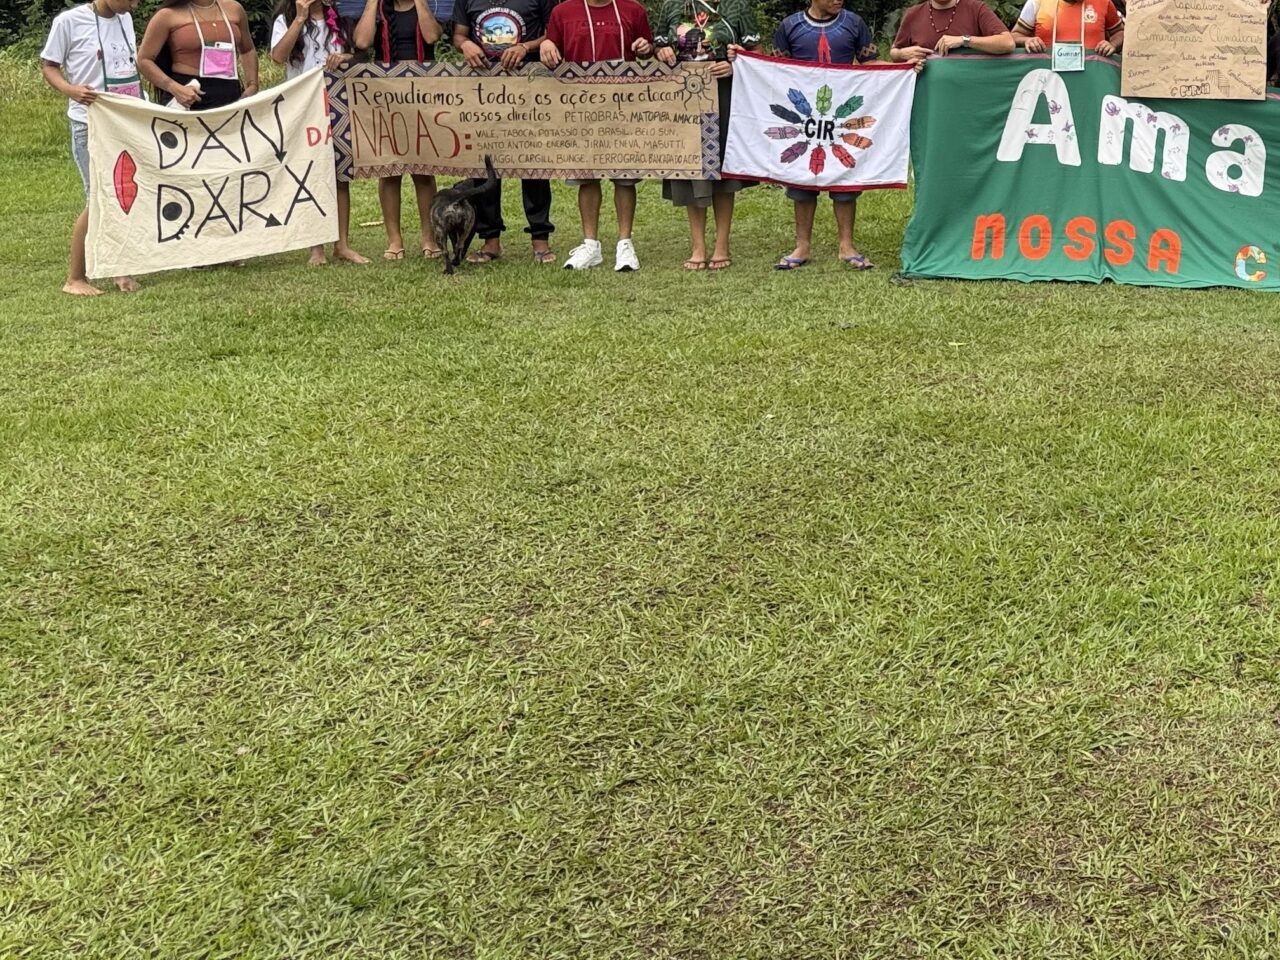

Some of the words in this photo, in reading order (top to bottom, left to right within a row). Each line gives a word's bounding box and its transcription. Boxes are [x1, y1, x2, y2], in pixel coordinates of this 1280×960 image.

[352, 81, 464, 112] Repudiamos
[472, 83, 526, 105] todas
[535, 93, 552, 105] as
[560, 90, 606, 109] ações
[612, 92, 634, 110] que
[638, 85, 684, 103] atacam
[459, 110, 502, 123] nossos
[507, 107, 551, 122] direitos
[352, 104, 410, 159] NÃO
[581, 128, 594, 137] DO
[804, 117, 835, 141] CIR
[476, 140, 504, 150] SANTO
